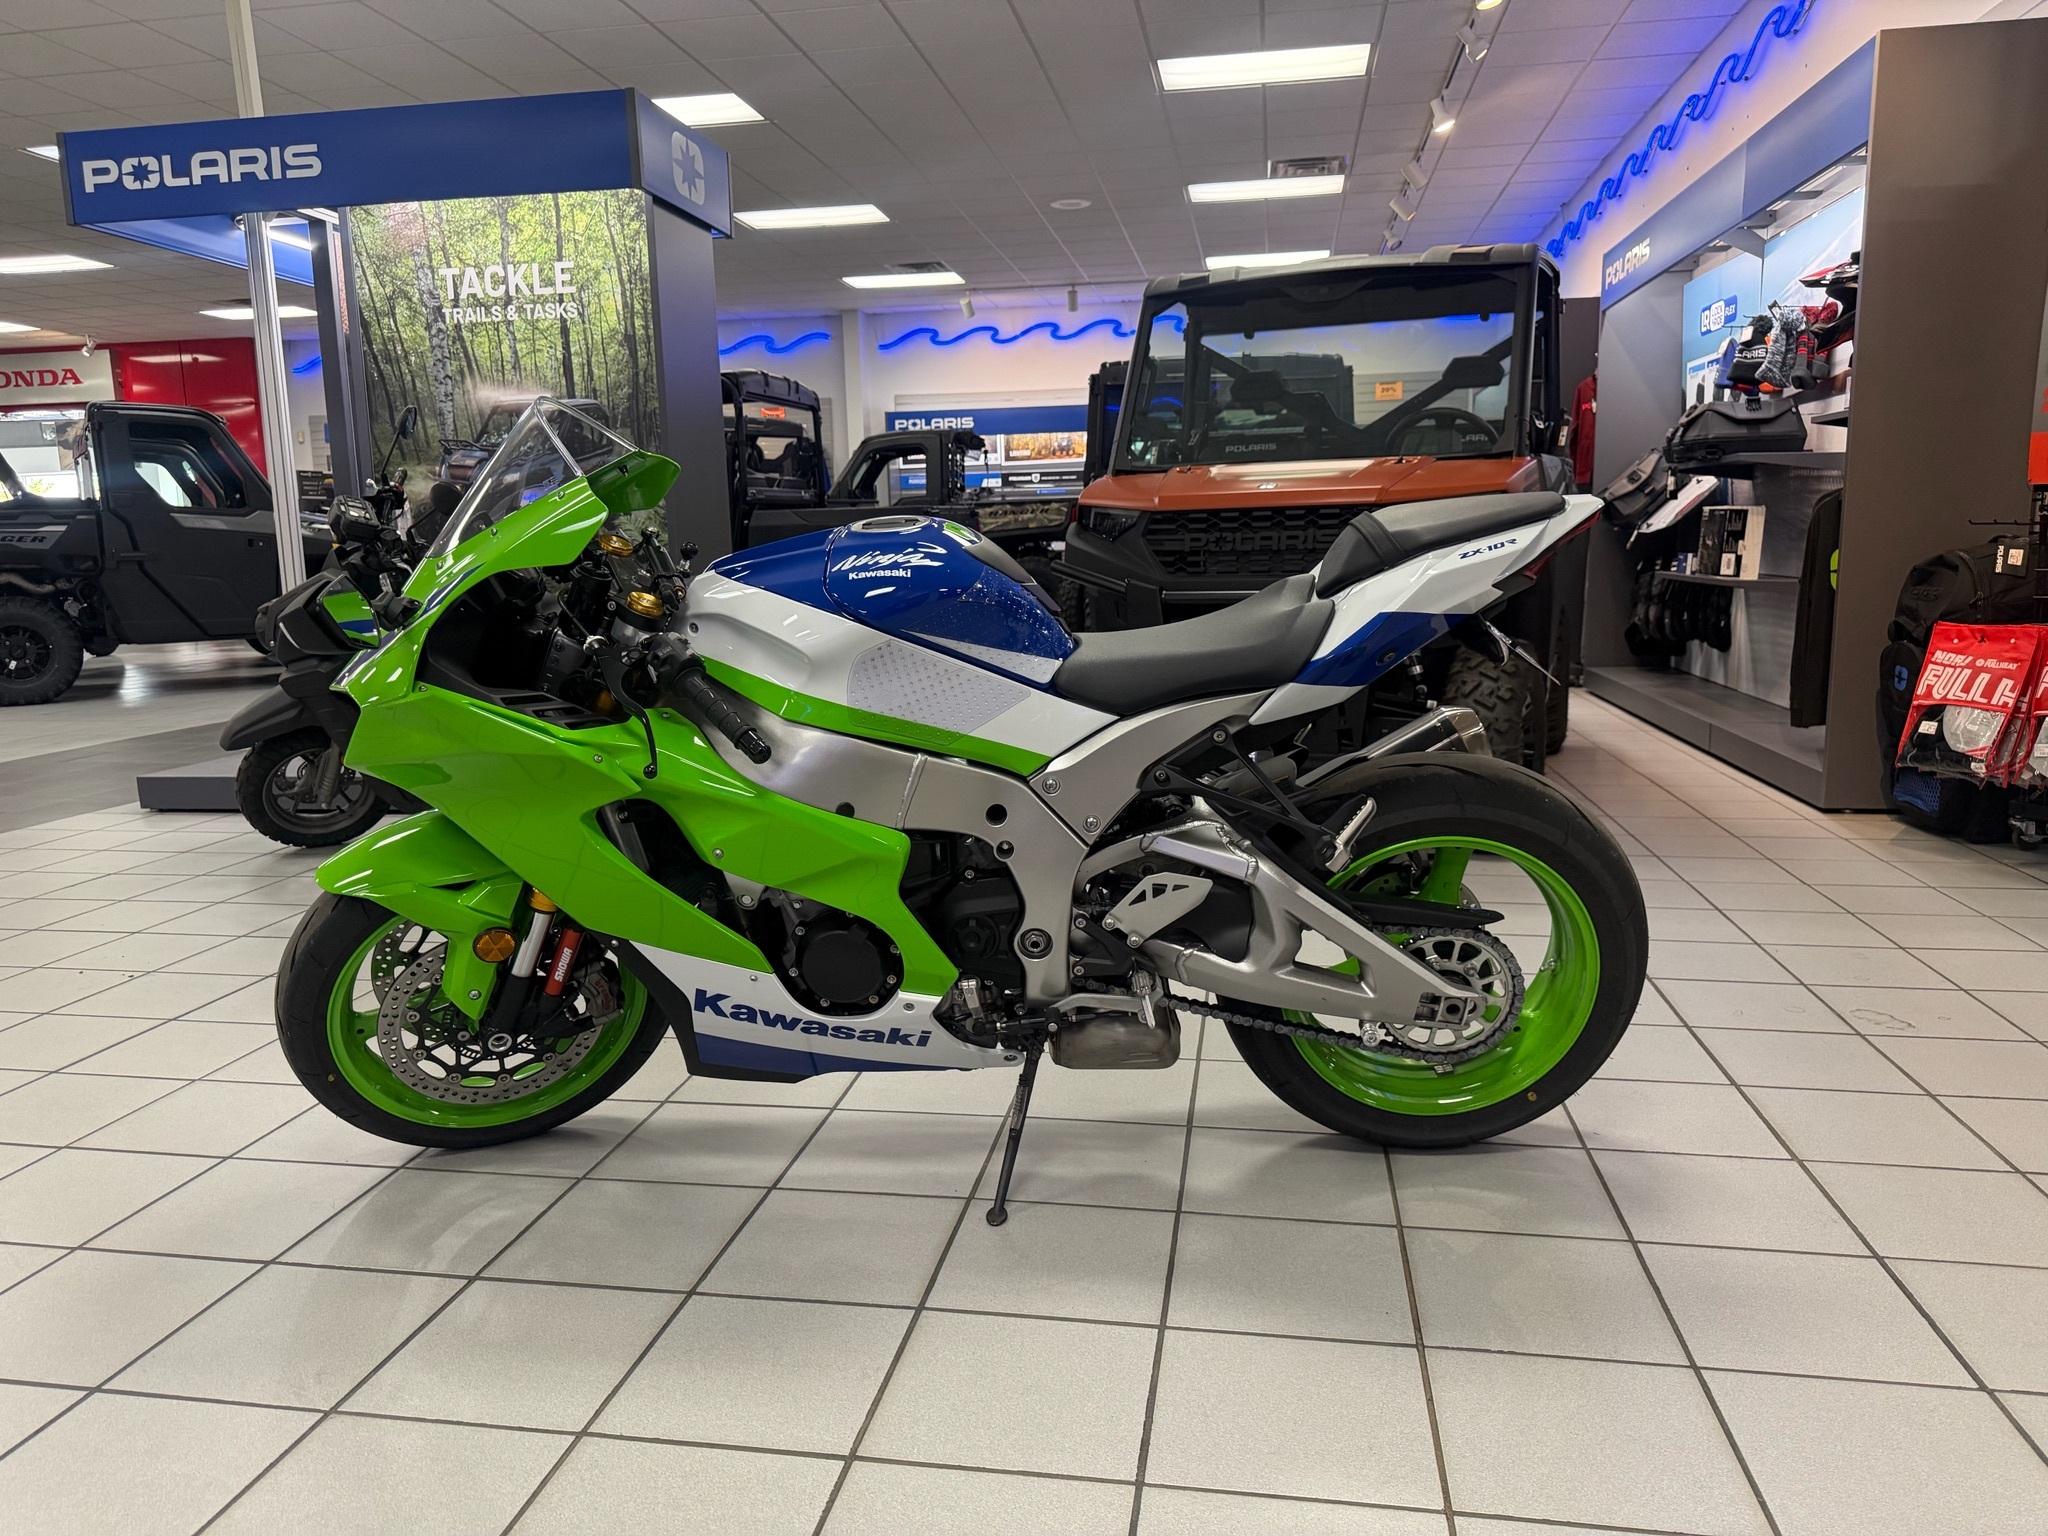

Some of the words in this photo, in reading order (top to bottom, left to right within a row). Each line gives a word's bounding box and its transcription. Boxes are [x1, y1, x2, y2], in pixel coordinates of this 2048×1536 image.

[82, 143, 322, 193] POLARIS
[1605, 237, 1650, 290] POLARIS
[438, 261, 577, 300] TACKLE
[442, 306, 502, 324] TRAILS
[506, 304, 518, 321] &
[523, 301, 578, 320] TASKS
[894, 416, 975, 431] POLARIS
[1225, 443, 1277, 453] POLARIS
[1184, 529, 1341, 552] POLARIS
[1458, 538, 1518, 560] ZX-10R
[831, 542, 947, 573] Ninja
[1994, 545, 2005, 573] POLARIS
[848, 568, 912, 580] Kawasaki
[1916, 663, 1992, 704] FULL
[554, 947, 573, 983] SHOWA
[693, 988, 933, 1047] Kawasaki
